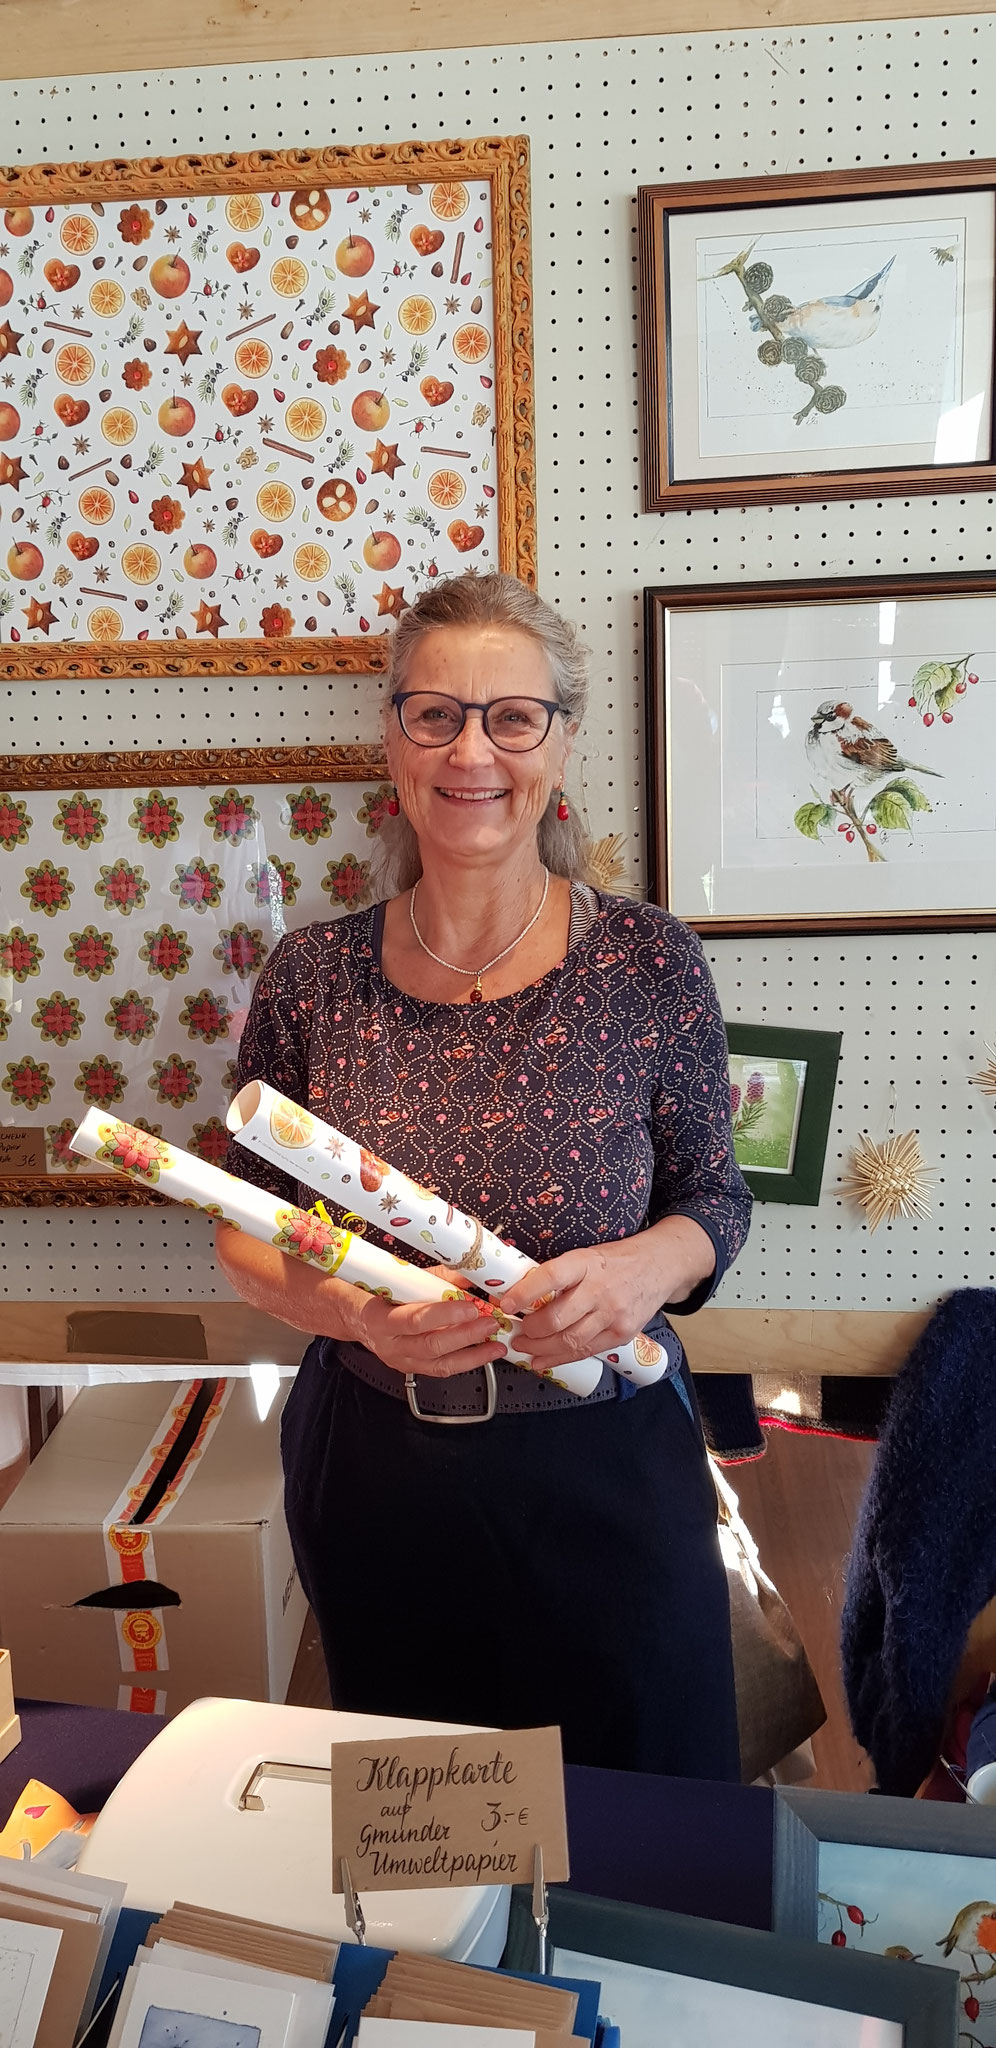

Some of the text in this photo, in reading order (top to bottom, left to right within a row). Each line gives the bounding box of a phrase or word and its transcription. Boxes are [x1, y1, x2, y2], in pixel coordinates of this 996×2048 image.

[356, 1746, 518, 1802] Klappkarte
[380, 1792, 412, 1830] auf
[369, 1840, 518, 1882] Umweltpapier
